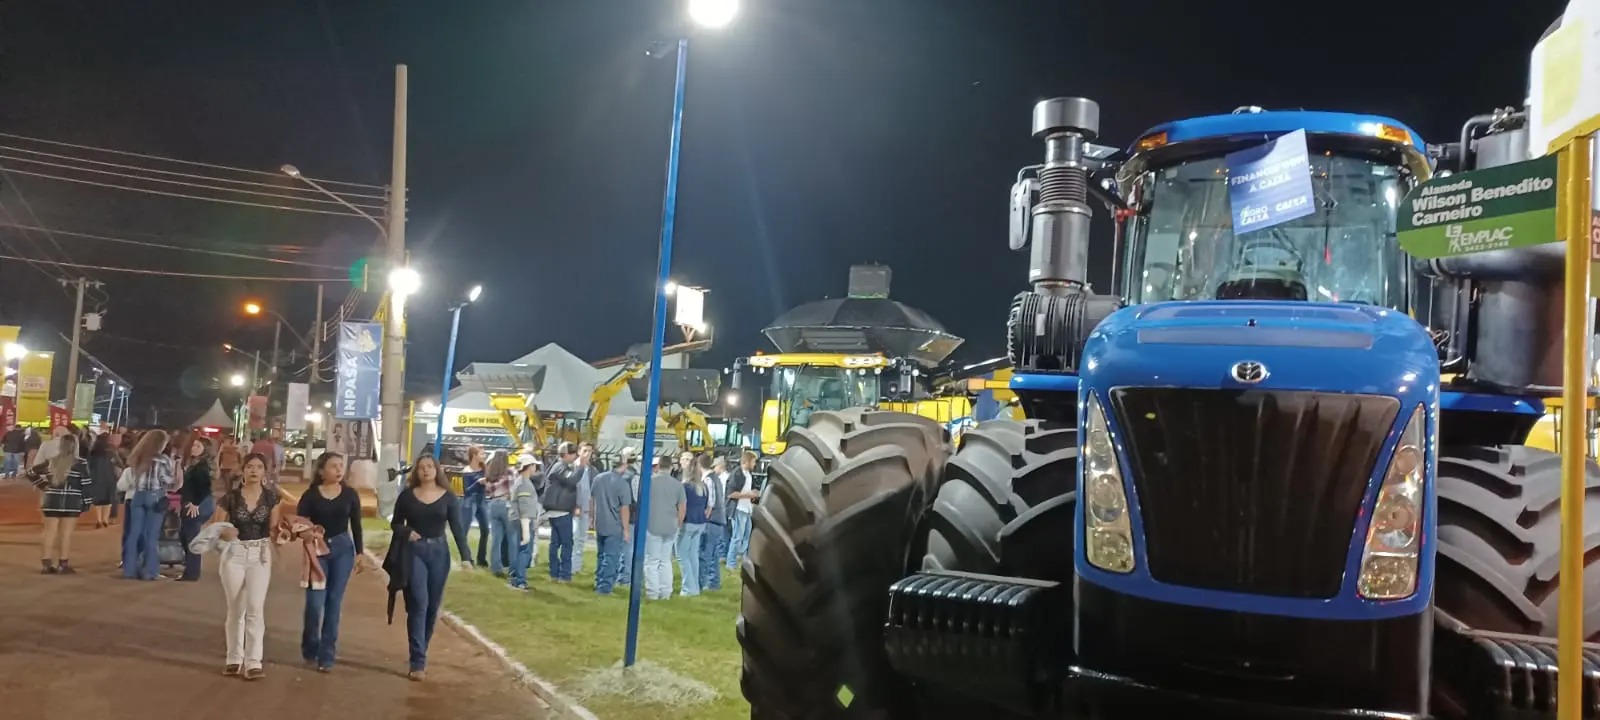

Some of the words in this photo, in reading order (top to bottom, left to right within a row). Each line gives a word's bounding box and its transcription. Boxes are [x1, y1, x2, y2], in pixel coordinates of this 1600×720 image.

[1412, 193, 1466, 212] Wilson
[1471, 177, 1553, 203] Benedito
[1421, 180, 1473, 197] Alameda
[1412, 204, 1484, 226] Carneiro
[1461, 226, 1514, 247] EMPLAC
[343, 356, 358, 416] INPASA
